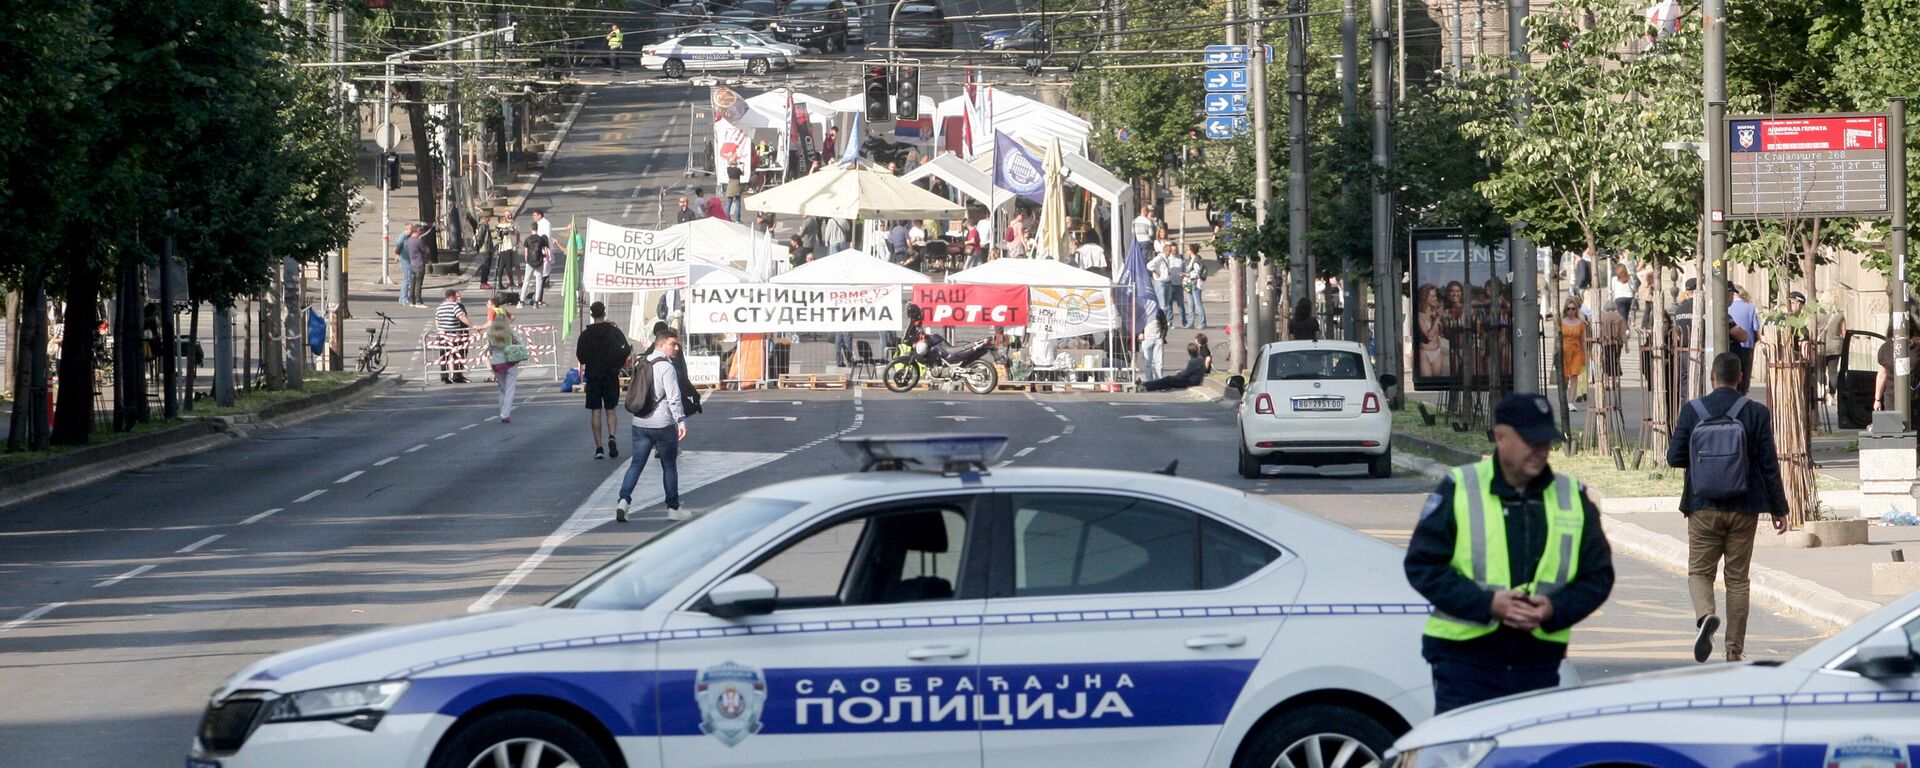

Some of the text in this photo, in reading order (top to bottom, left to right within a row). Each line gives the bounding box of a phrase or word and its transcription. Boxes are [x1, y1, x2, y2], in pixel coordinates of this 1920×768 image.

[1233, 71, 1241, 81] P
[1828, 151, 1846, 159] 268
[623, 230, 655, 246] БЕЗ
[589, 239, 686, 262] РЕВОЛУЦИЈЕ
[614, 260, 655, 276] НЕМА
[691, 287, 889, 306] НАУЧНИЦИ раме уз
[920, 288, 966, 303] НАШ
[709, 306, 894, 325] СА СТУДЕНТИМА
[921, 304, 1019, 322] ПРОТЕСТ
[795, 673, 1135, 694] САОБРАЋАЈНА
[795, 691, 1135, 725] ПОЛИЦИЈА
